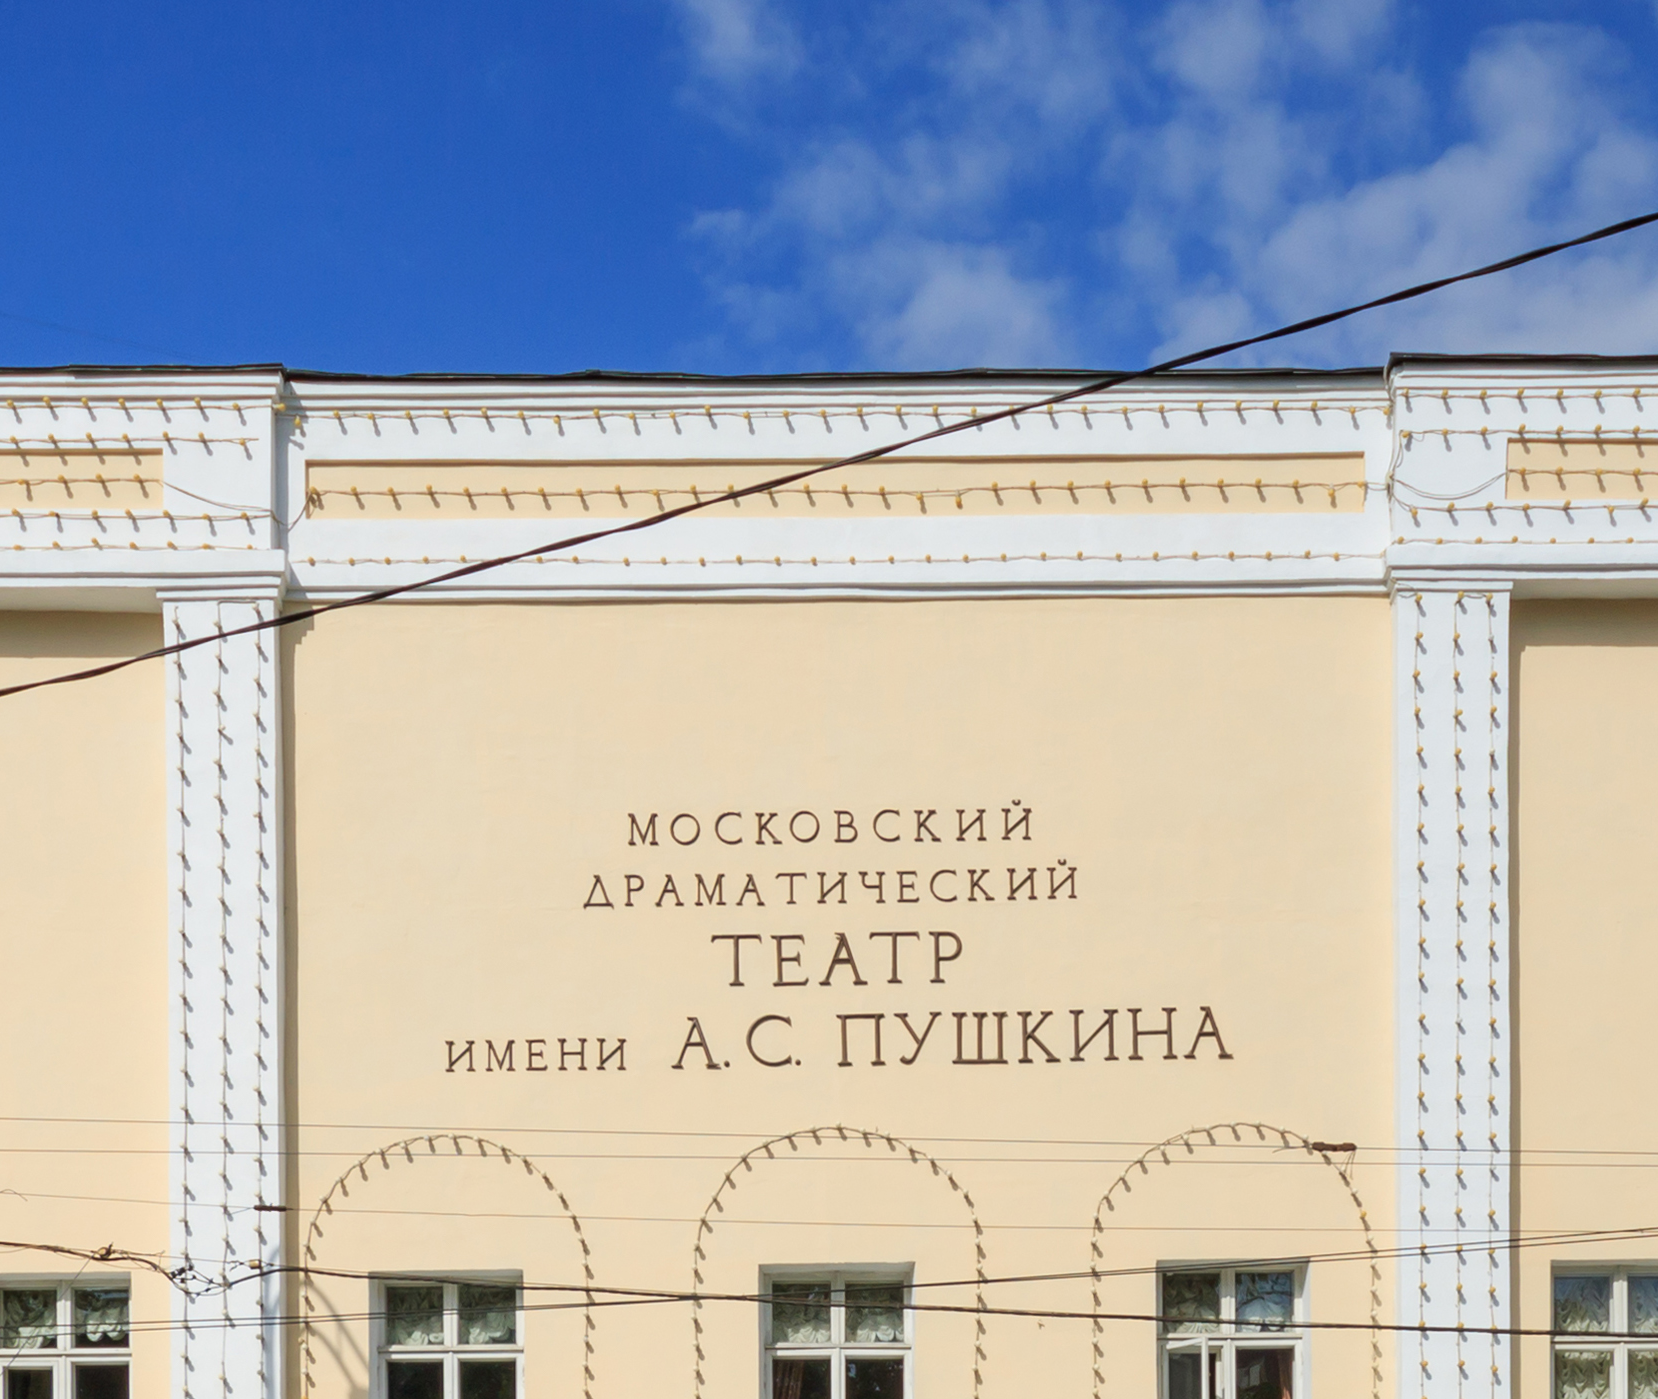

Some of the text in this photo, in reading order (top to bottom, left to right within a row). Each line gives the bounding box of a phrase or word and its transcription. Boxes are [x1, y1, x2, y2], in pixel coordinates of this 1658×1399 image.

[627, 799, 1033, 846] МОСКОВСКИЙ
[583, 858, 1079, 910] ДРАМАТИЧЕСКИЙ
[710, 930, 963, 987] ТЕАТР
[444, 1038, 627, 1072] ИМЕНИ
[835, 1005, 1234, 1067] ПУШКИНА
